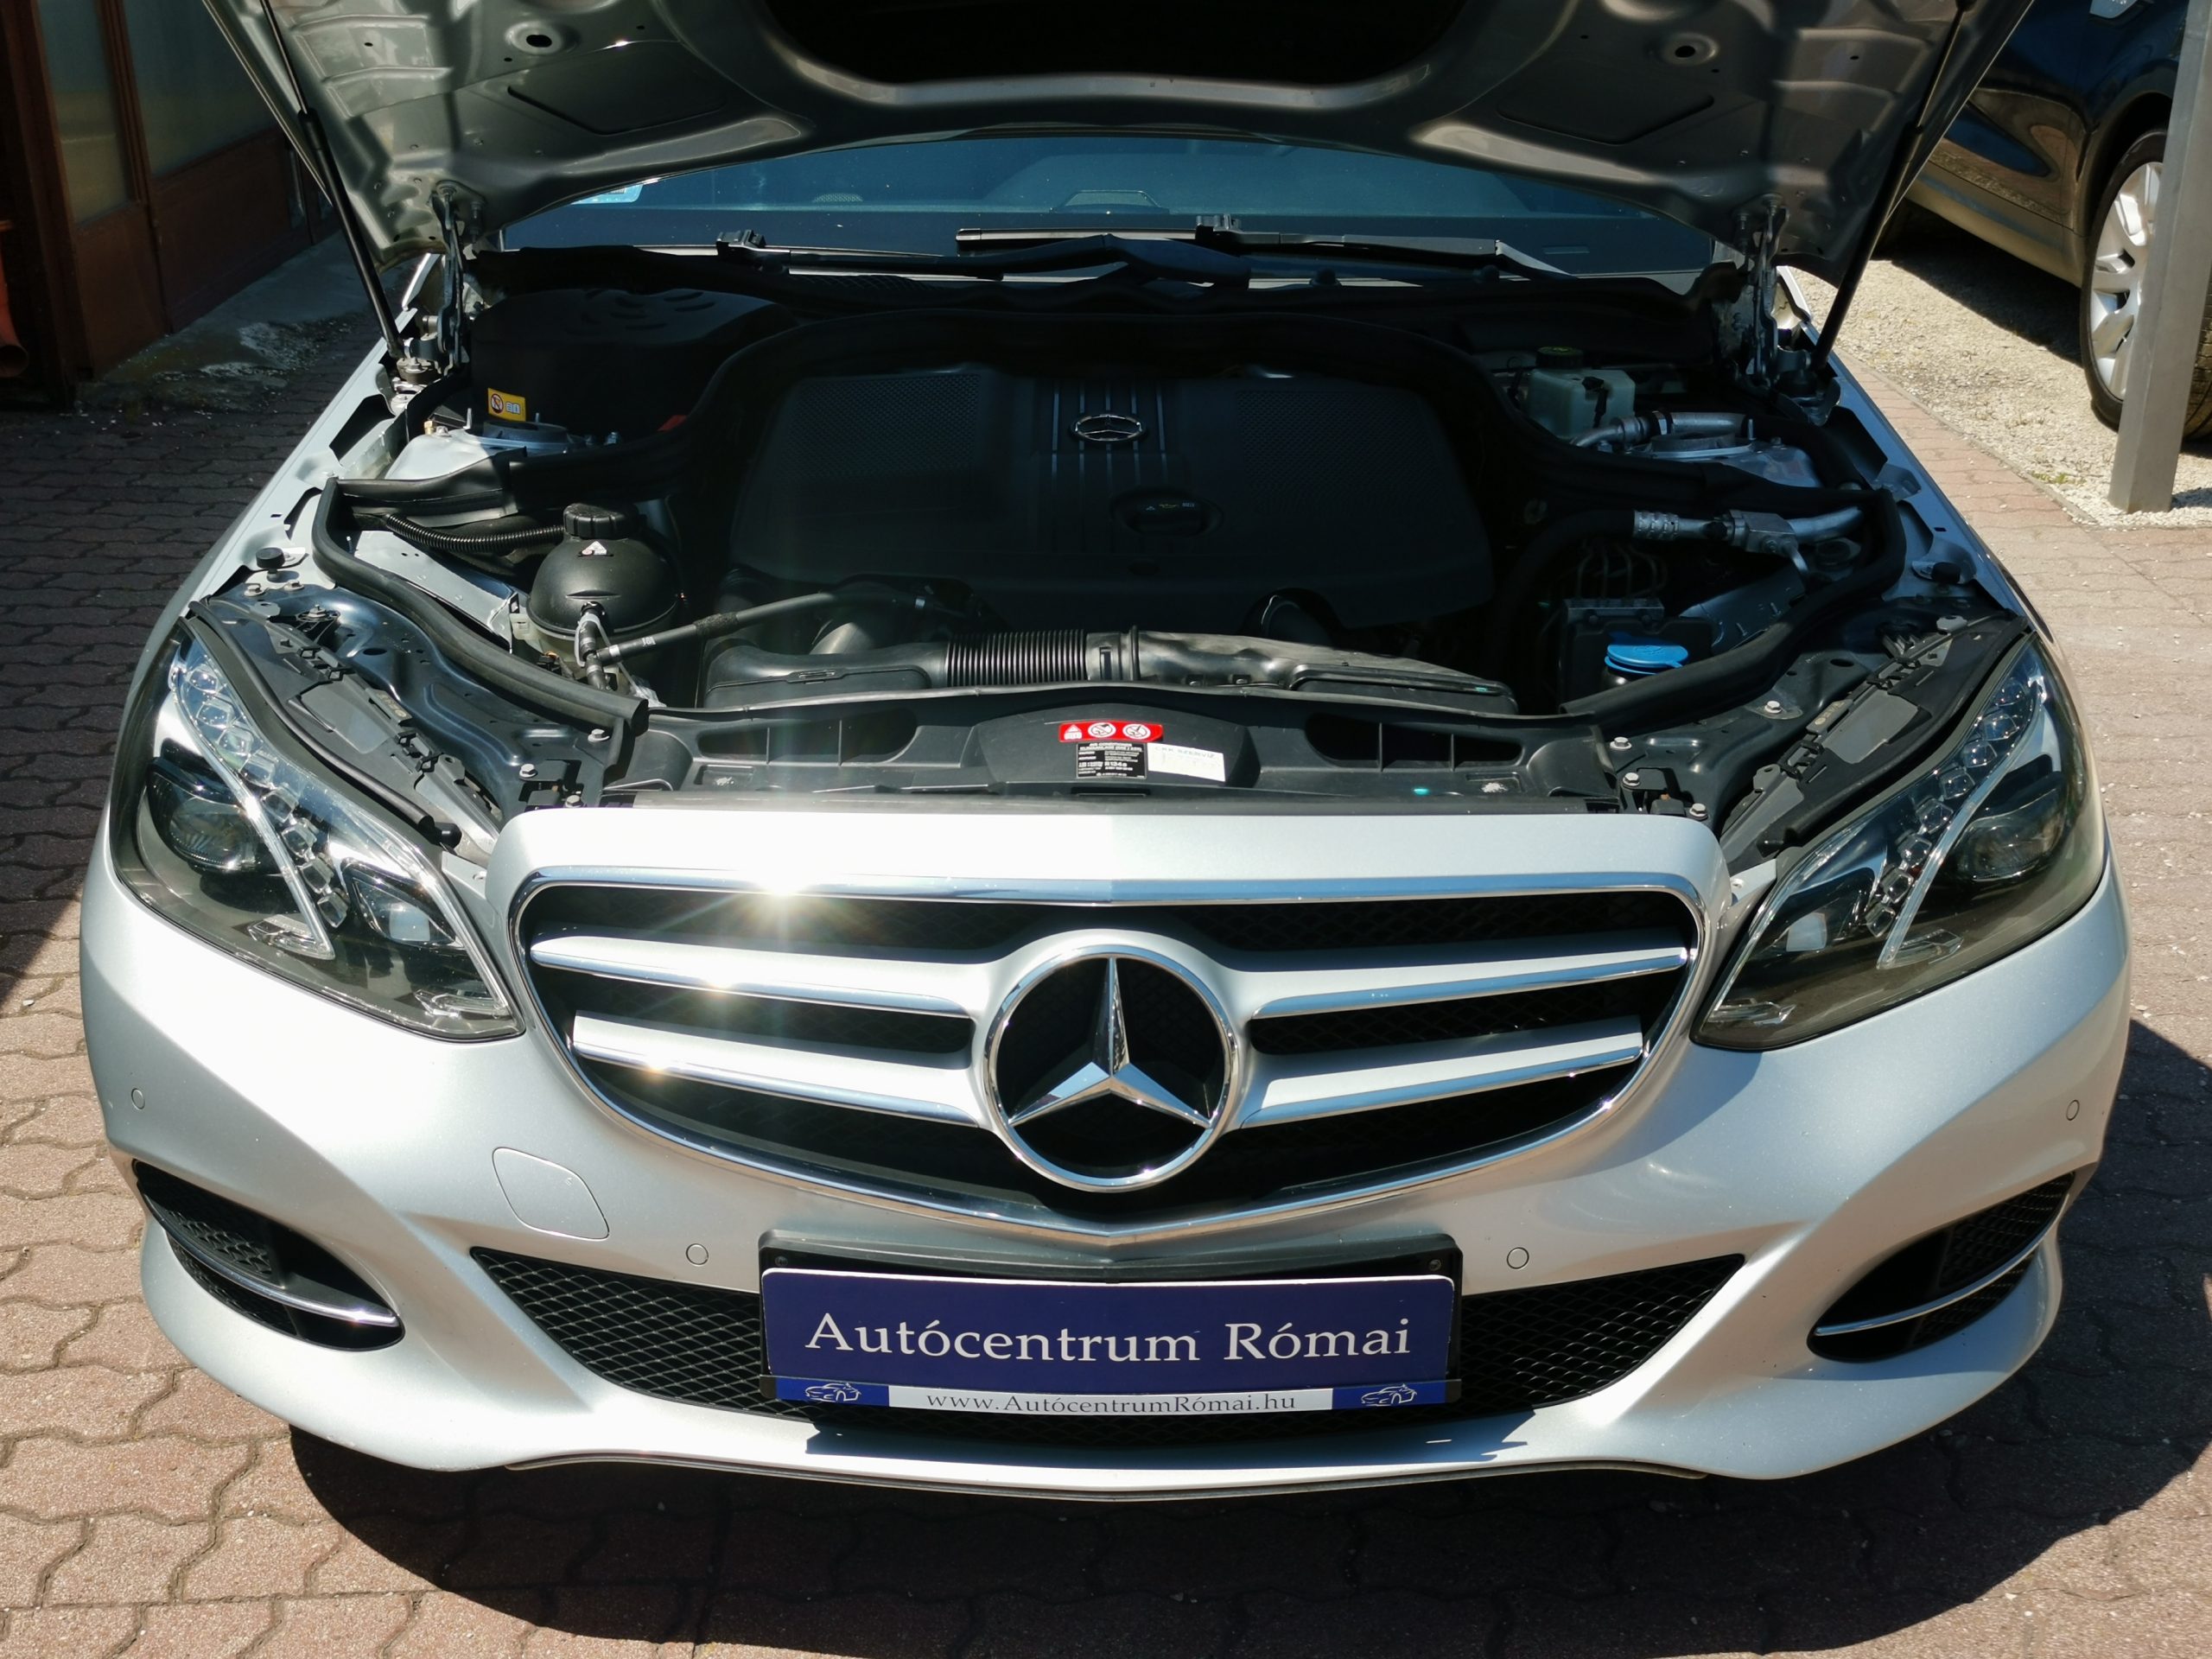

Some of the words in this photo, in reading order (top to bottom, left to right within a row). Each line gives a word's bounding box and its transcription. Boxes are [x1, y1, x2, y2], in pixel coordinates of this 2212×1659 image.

[804, 1313, 1200, 1362] Autócentrum
[1224, 1317, 1410, 1360] Római
[926, 1392, 1296, 1414] www.AutócentrumRómai.hu
